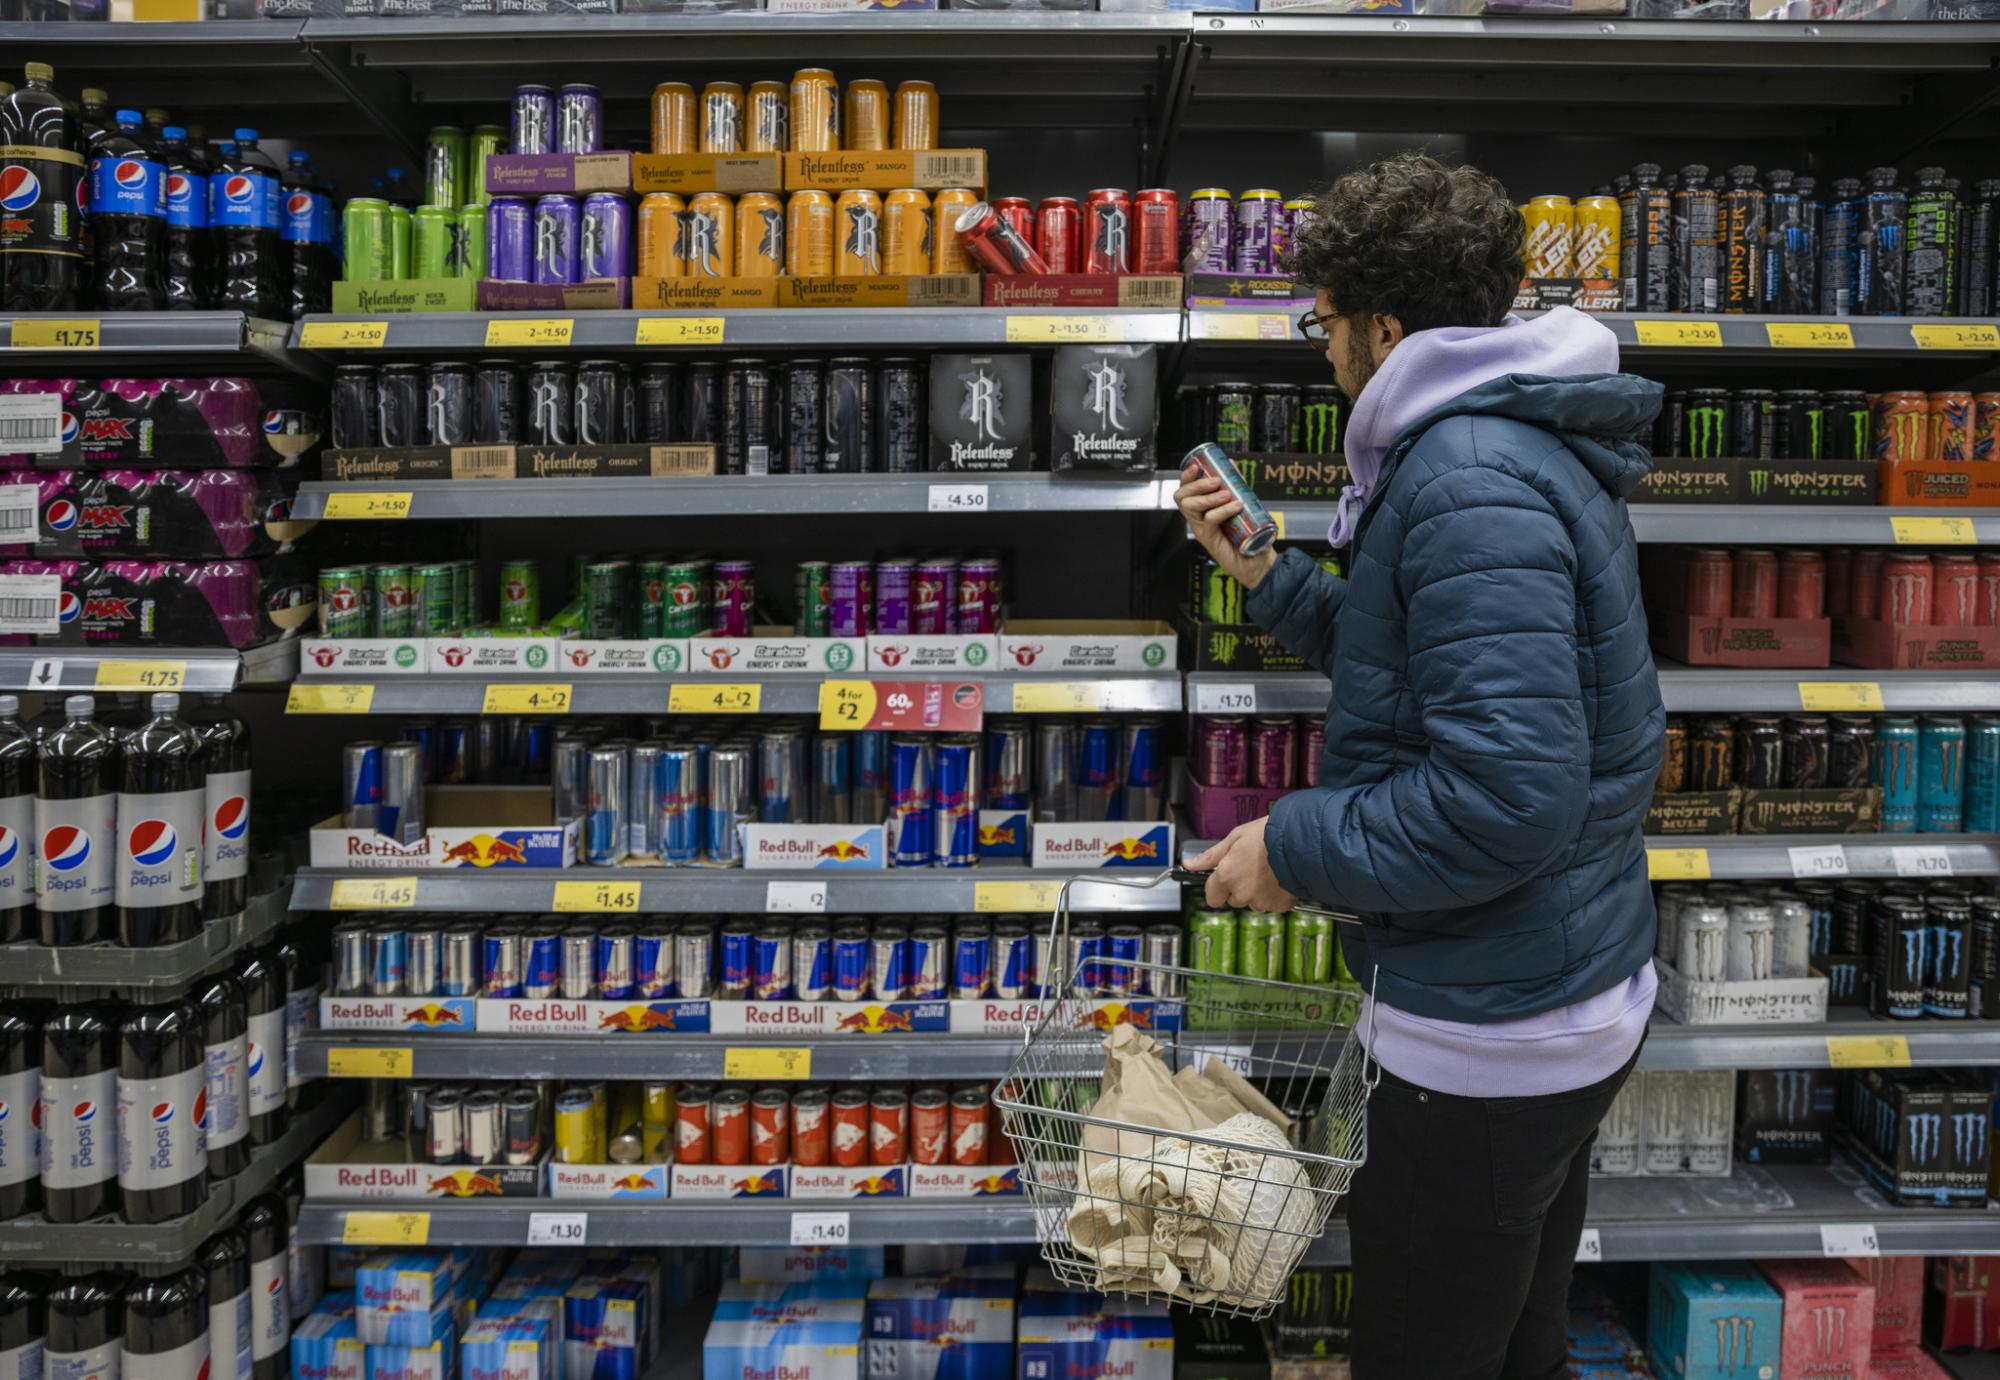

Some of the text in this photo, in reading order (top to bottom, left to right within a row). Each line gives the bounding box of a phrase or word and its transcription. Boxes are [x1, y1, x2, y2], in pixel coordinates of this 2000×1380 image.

[7, 148, 37, 156] caffeine
[494, 164, 539, 180] Relentless
[800, 155, 865, 183] Relentless
[875, 163, 906, 171] MANGO
[641, 166, 686, 184] Relentless
[117, 191, 144, 201] pepsi
[1729, 203, 1745, 301] MONSTER
[657, 279, 722, 305] Relentless
[731, 288, 762, 296] MANGO
[791, 278, 858, 302] Relentless
[993, 281, 1060, 306] Relentless
[1070, 288, 1103, 296] CHERRY
[358, 288, 415, 313] Relentless
[1512, 297, 1539, 308] ERT
[1571, 298, 1622, 309] ALERT
[343, 330, 380, 340] 2 £1.50
[530, 328, 567, 338] 2 £1.50
[680, 326, 719, 336] 2 £1.50
[1049, 324, 1088, 334] 2 £1.50
[1679, 330, 1716, 340] 2 £2.50
[56, 329, 94, 346] £1.75
[1810, 332, 1847, 342] 2 £2.50
[1958, 332, 1995, 342] 2 £2.50
[80, 417, 137, 440] MAX
[1072, 430, 1136, 460] Relentless
[950, 440, 1013, 468] Relentless
[335, 455, 400, 480] Relentless
[532, 453, 598, 478] Relentless
[609, 458, 638, 466] ORIGIN
[1264, 460, 1348, 485] MONST
[1774, 470, 1866, 488] MONSTER
[1924, 473, 1969, 483] JUICED
[1790, 488, 1850, 496] ENERGY
[368, 500, 406, 510] 2 £1.50
[948, 494, 984, 506] £4.50
[79, 505, 134, 527] MAX
[81, 597, 139, 620] MAX
[747, 661, 781, 669] ENERGY
[141, 671, 179, 686] £1.75
[528, 691, 566, 708] 4 £2
[713, 691, 752, 706] 4 £2
[837, 688, 863, 699] 4 for
[886, 693, 913, 709] 60p
[1220, 695, 1253, 707] £1.70
[838, 704, 858, 720] £2
[1777, 801, 1855, 815] MONSTER
[1661, 820, 1708, 829] MULE
[759, 840, 814, 853] Red Bull
[1045, 839, 1100, 852] Red Bull
[1812, 855, 1844, 870] £1.70
[1916, 857, 1948, 870] £1.70
[46, 877, 87, 892] pepsi
[131, 873, 172, 888] pepsi
[372, 887, 411, 905] £1.45
[596, 892, 635, 909] £1.45
[811, 893, 824, 906] £2
[1729, 994, 1812, 1006] MONSTER
[331, 1004, 393, 1019] Red Bull
[509, 1004, 587, 1021] Red Bull
[746, 1006, 824, 1024] Red Bull
[985, 1004, 1022, 1022] Red
[79, 1126, 94, 1169] pepsi
[156, 1127, 171, 1169] pepsi
[338, 1168, 417, 1186] Red Bull
[558, 1174, 605, 1184] Red Bull
[676, 1175, 725, 1186] Red Bull
[795, 1175, 845, 1187] Red Bull
[915, 1175, 965, 1187] Red Bull
[361, 1188, 394, 1197] ZERO
[550, 1223, 582, 1238] £1.30
[812, 1225, 846, 1239] £1.40
[1585, 1241, 1599, 1254] £5
[1862, 1236, 1875, 1250] £5
[364, 1286, 421, 1301] Red Bull
